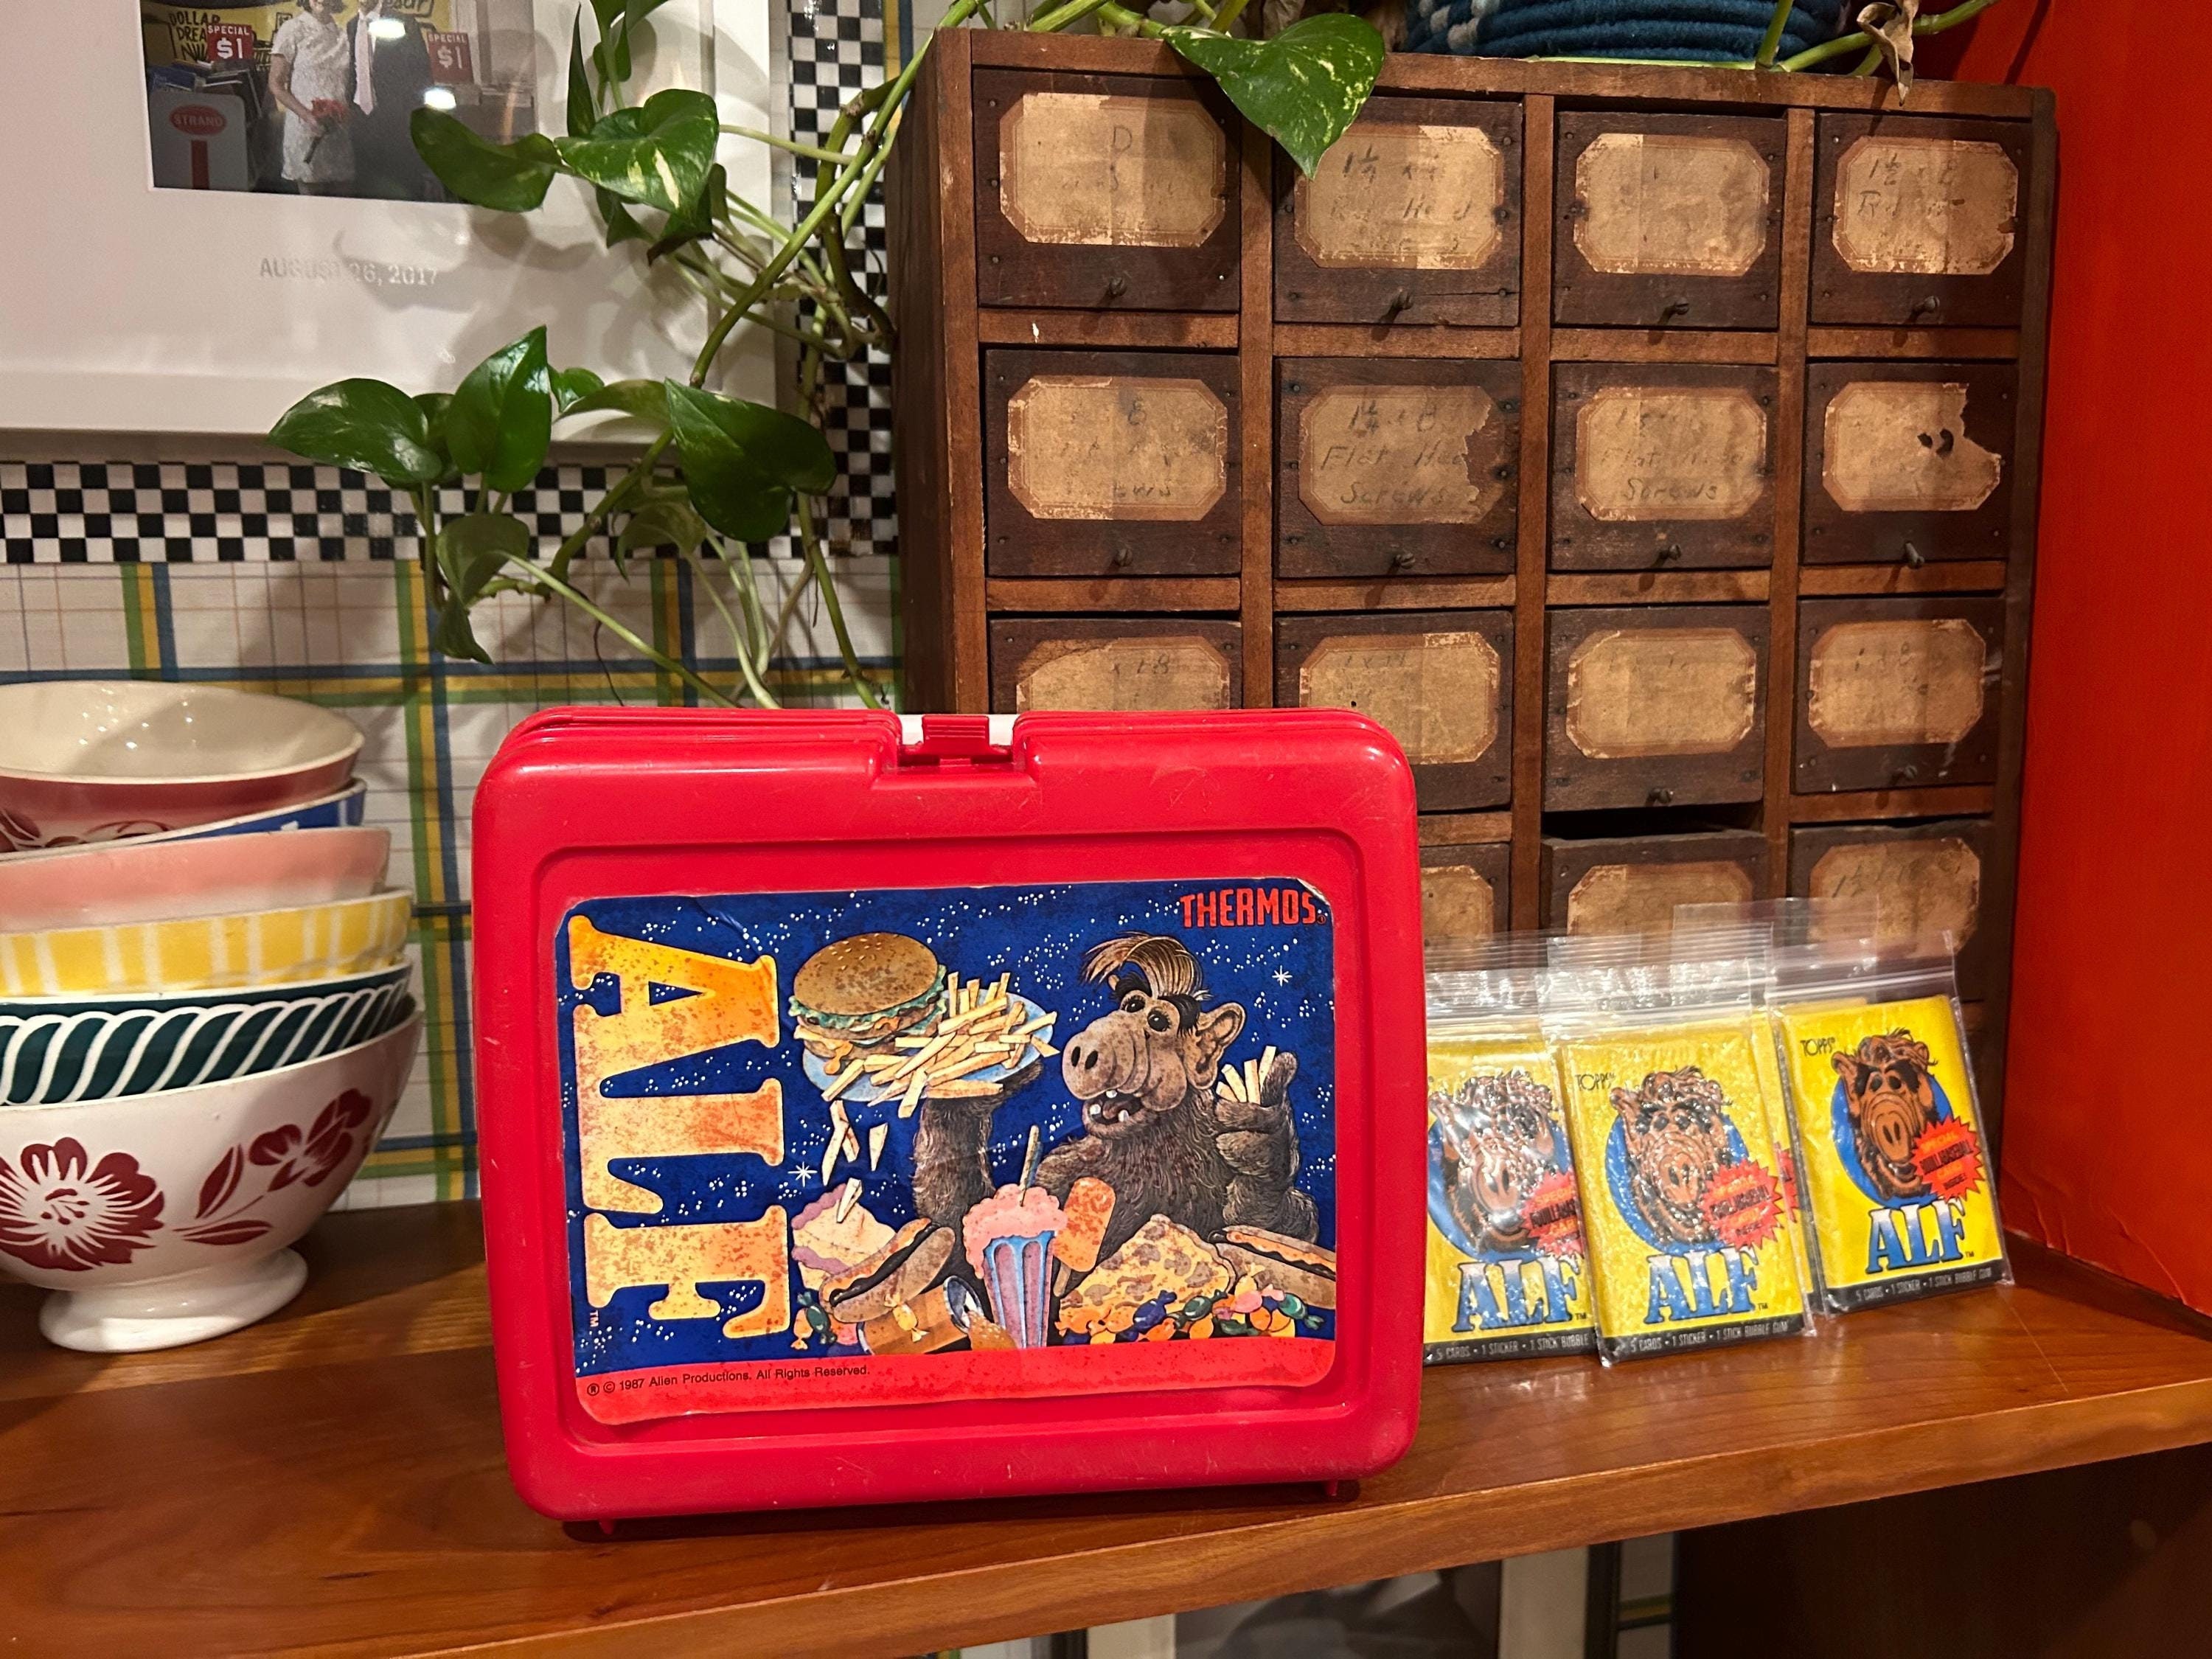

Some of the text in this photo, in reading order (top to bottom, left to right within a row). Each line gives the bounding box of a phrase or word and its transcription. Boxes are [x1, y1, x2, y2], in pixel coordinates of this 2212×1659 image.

[176, 26, 207, 42] DREA
[208, 25, 250, 35] SPECIAL
[428, 32, 466, 44] SPECIAL
[217, 38, 243, 59] $1
[437, 46, 462, 69] $1
[173, 114, 223, 127] STRAND
[260, 258, 437, 285] AUGUST 26, 2017
[1180, 888, 1317, 928] THERMOS
[568, 914, 790, 1339] ALF
[1865, 1197, 1966, 1275] ALF
[1451, 1256, 1581, 1332] ALF
[1644, 1246, 1760, 1325] ALF
[1489, 1340, 1520, 1355] STICKER
[1561, 1332, 1590, 1348] BUBBLE
[1679, 1331, 1707, 1346] STICKER
[1722, 1326, 1742, 1340] STICK
[619, 1378, 645, 1391] 1987
[649, 1375, 678, 1388] Alien
[683, 1370, 752, 1384] Productions.
[757, 1368, 771, 1380] All
[775, 1367, 810, 1380] Rights
[815, 1365, 870, 1377] Reserved.
